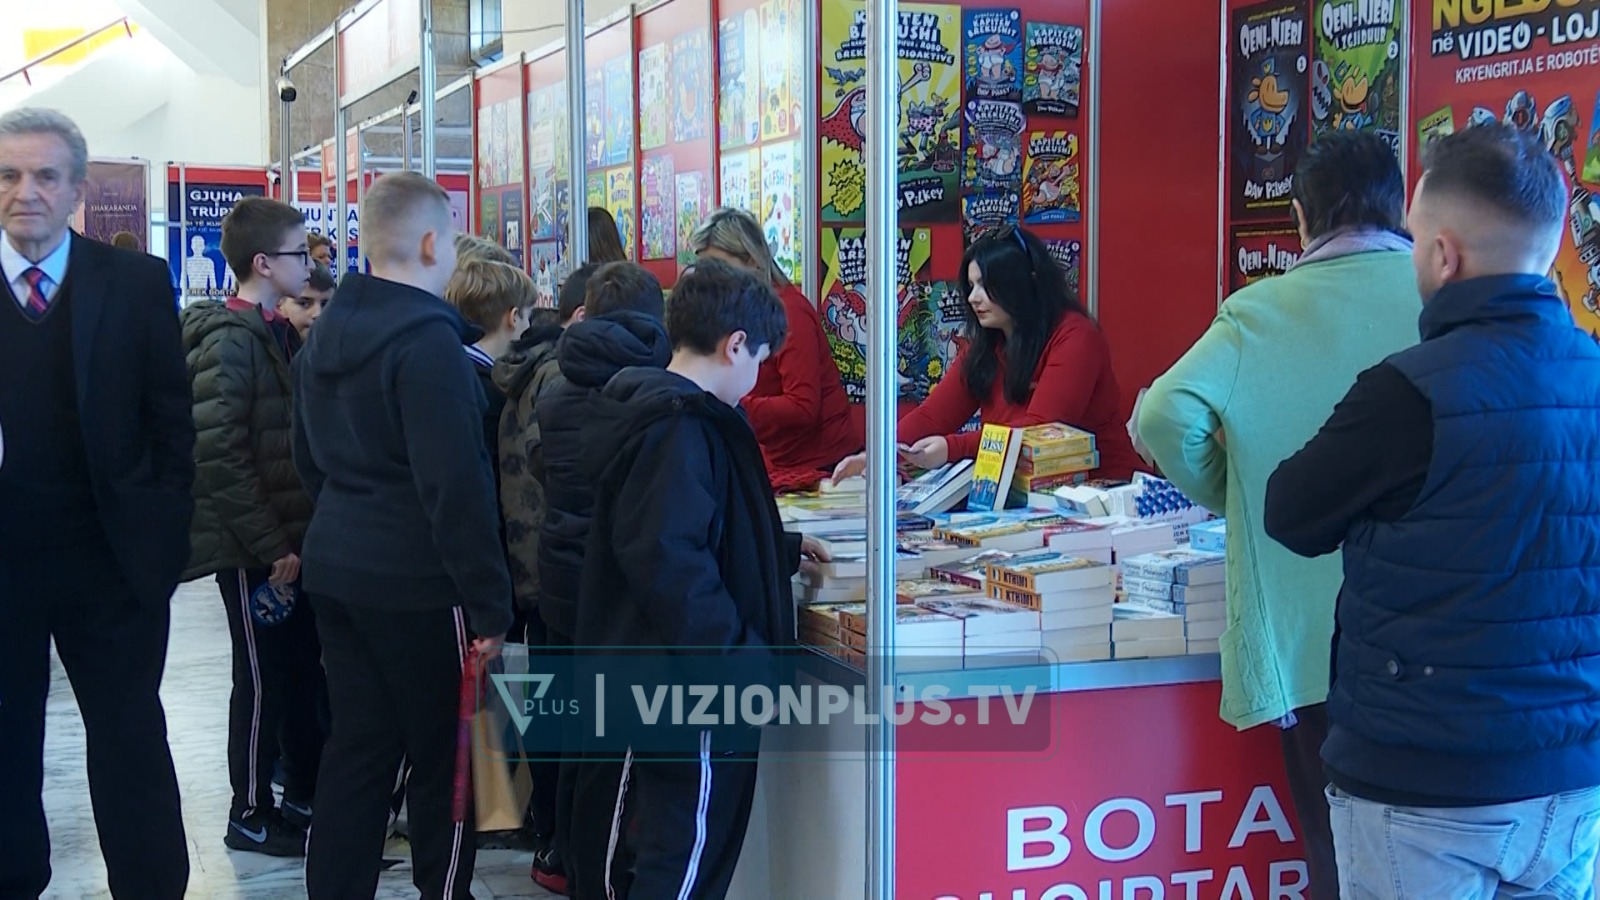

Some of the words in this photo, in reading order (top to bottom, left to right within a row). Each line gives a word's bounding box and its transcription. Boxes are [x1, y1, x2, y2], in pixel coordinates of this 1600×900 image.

[849, 24, 938, 42] BUSHI
[854, 10, 937, 28] KTEN
[1322, 0, 1394, 40] QENI-NJERI
[1240, 16, 1303, 60] QENI-NJERI
[1432, 31, 1454, 54] në
[1458, 20, 1531, 59] VIDEO
[898, 49, 954, 65] DIOAKTIVE
[1456, 60, 1534, 84] KRYENGRITJA
[1536, 55, 1544, 72] E
[1547, 43, 1600, 71] ROBOTË
[190, 190, 243, 202] GJUHA
[1004, 571, 1028, 589] KTHIMI
[1006, 590, 1033, 607] KTHIMI
[1006, 784, 1297, 872] BOTA
[930, 857, 1310, 900] PTAR
